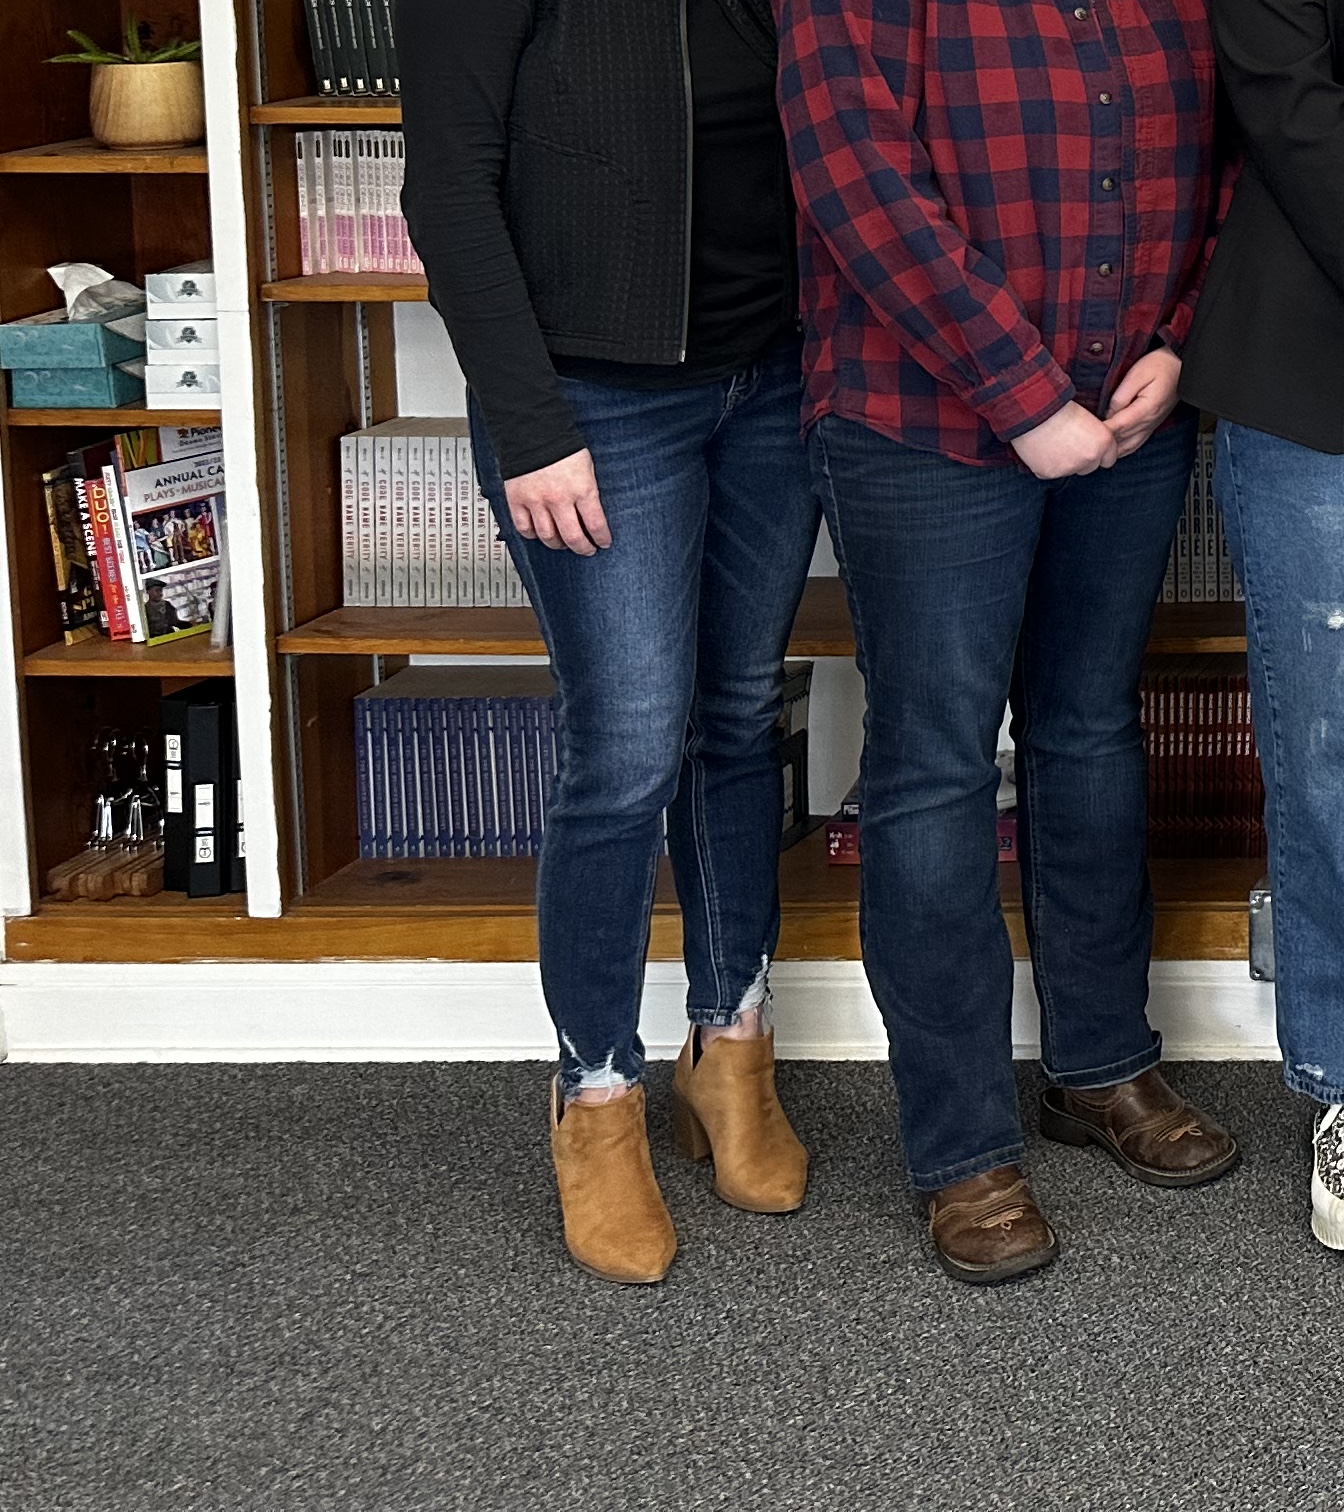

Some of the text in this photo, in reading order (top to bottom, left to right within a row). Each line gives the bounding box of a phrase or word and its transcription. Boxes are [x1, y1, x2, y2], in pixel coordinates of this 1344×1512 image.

[155, 468, 205, 488] ANNUAL
[144, 488, 175, 502] PLAYS
[74, 478, 97, 556] MAKE A SCENE
